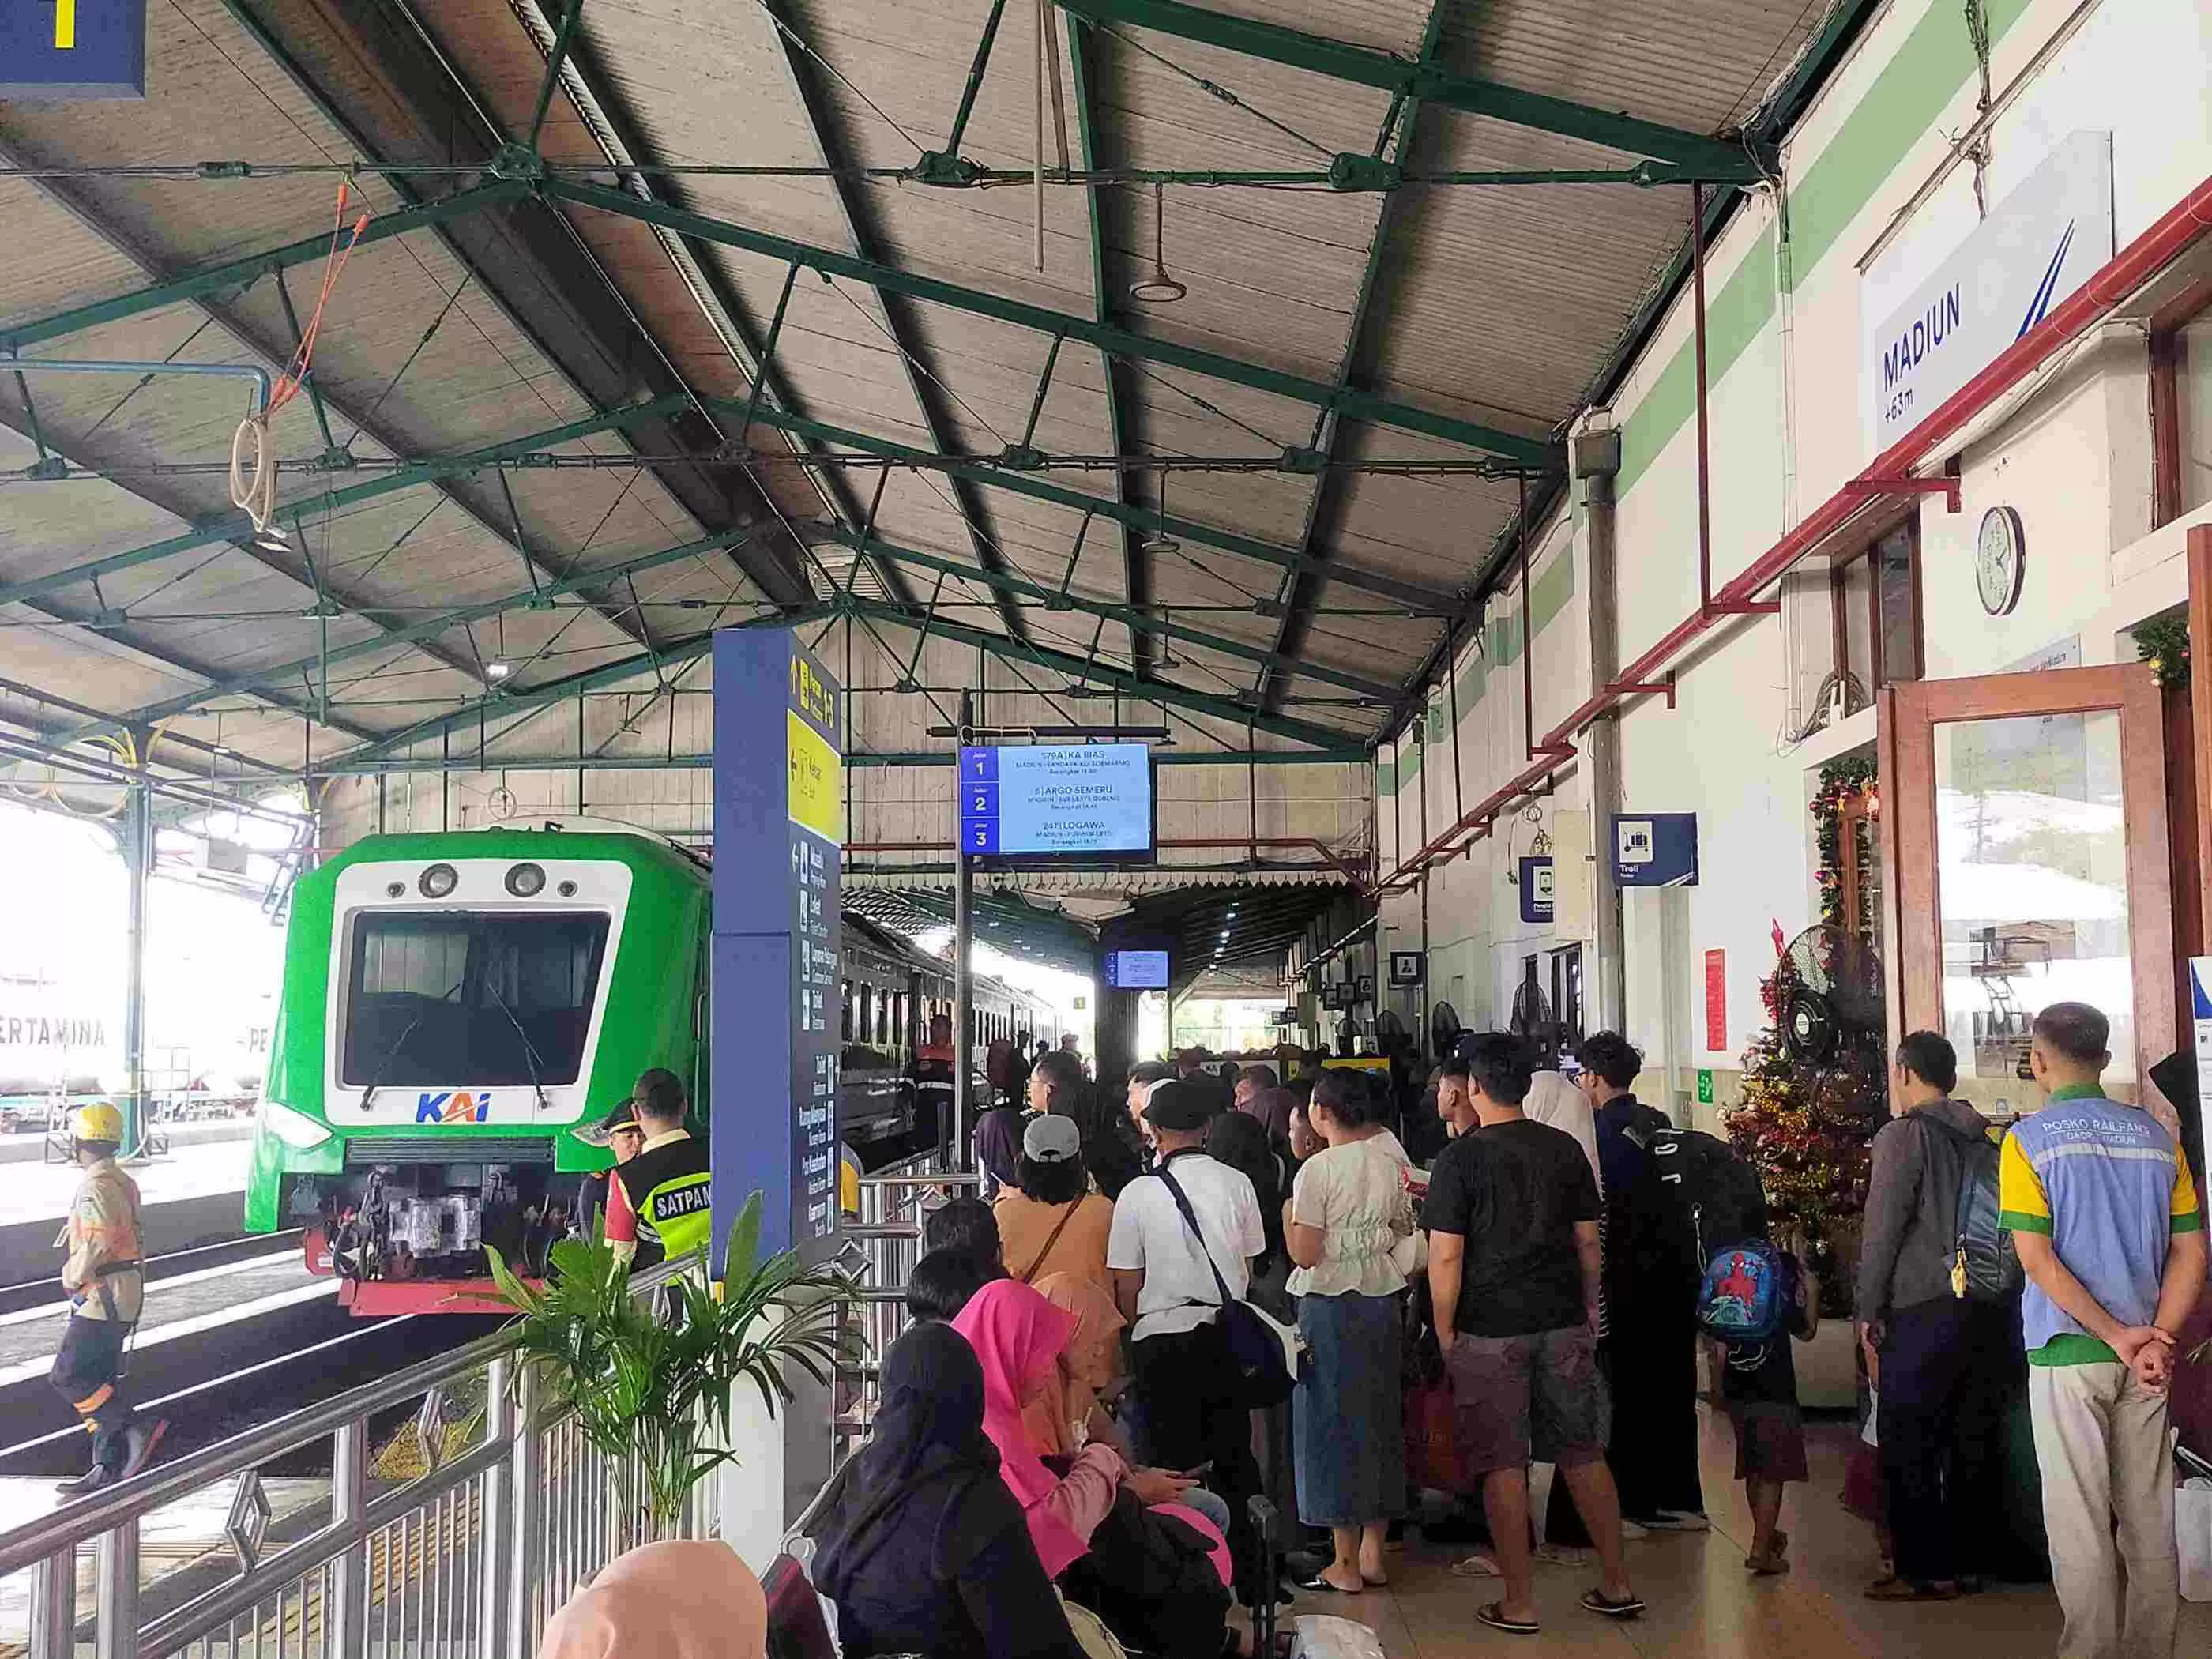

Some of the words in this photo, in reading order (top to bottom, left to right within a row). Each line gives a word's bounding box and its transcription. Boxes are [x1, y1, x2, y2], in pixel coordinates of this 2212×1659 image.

[1883, 281, 1960, 393] MADIUN
[975, 762, 984, 775] 1
[1045, 786, 1072, 795] ARGO
[975, 796, 987, 811] 2
[1063, 821, 1105, 830] LOGAWA
[975, 832, 987, 847] 3
[2042, 1119, 2089, 1132] POSKO
